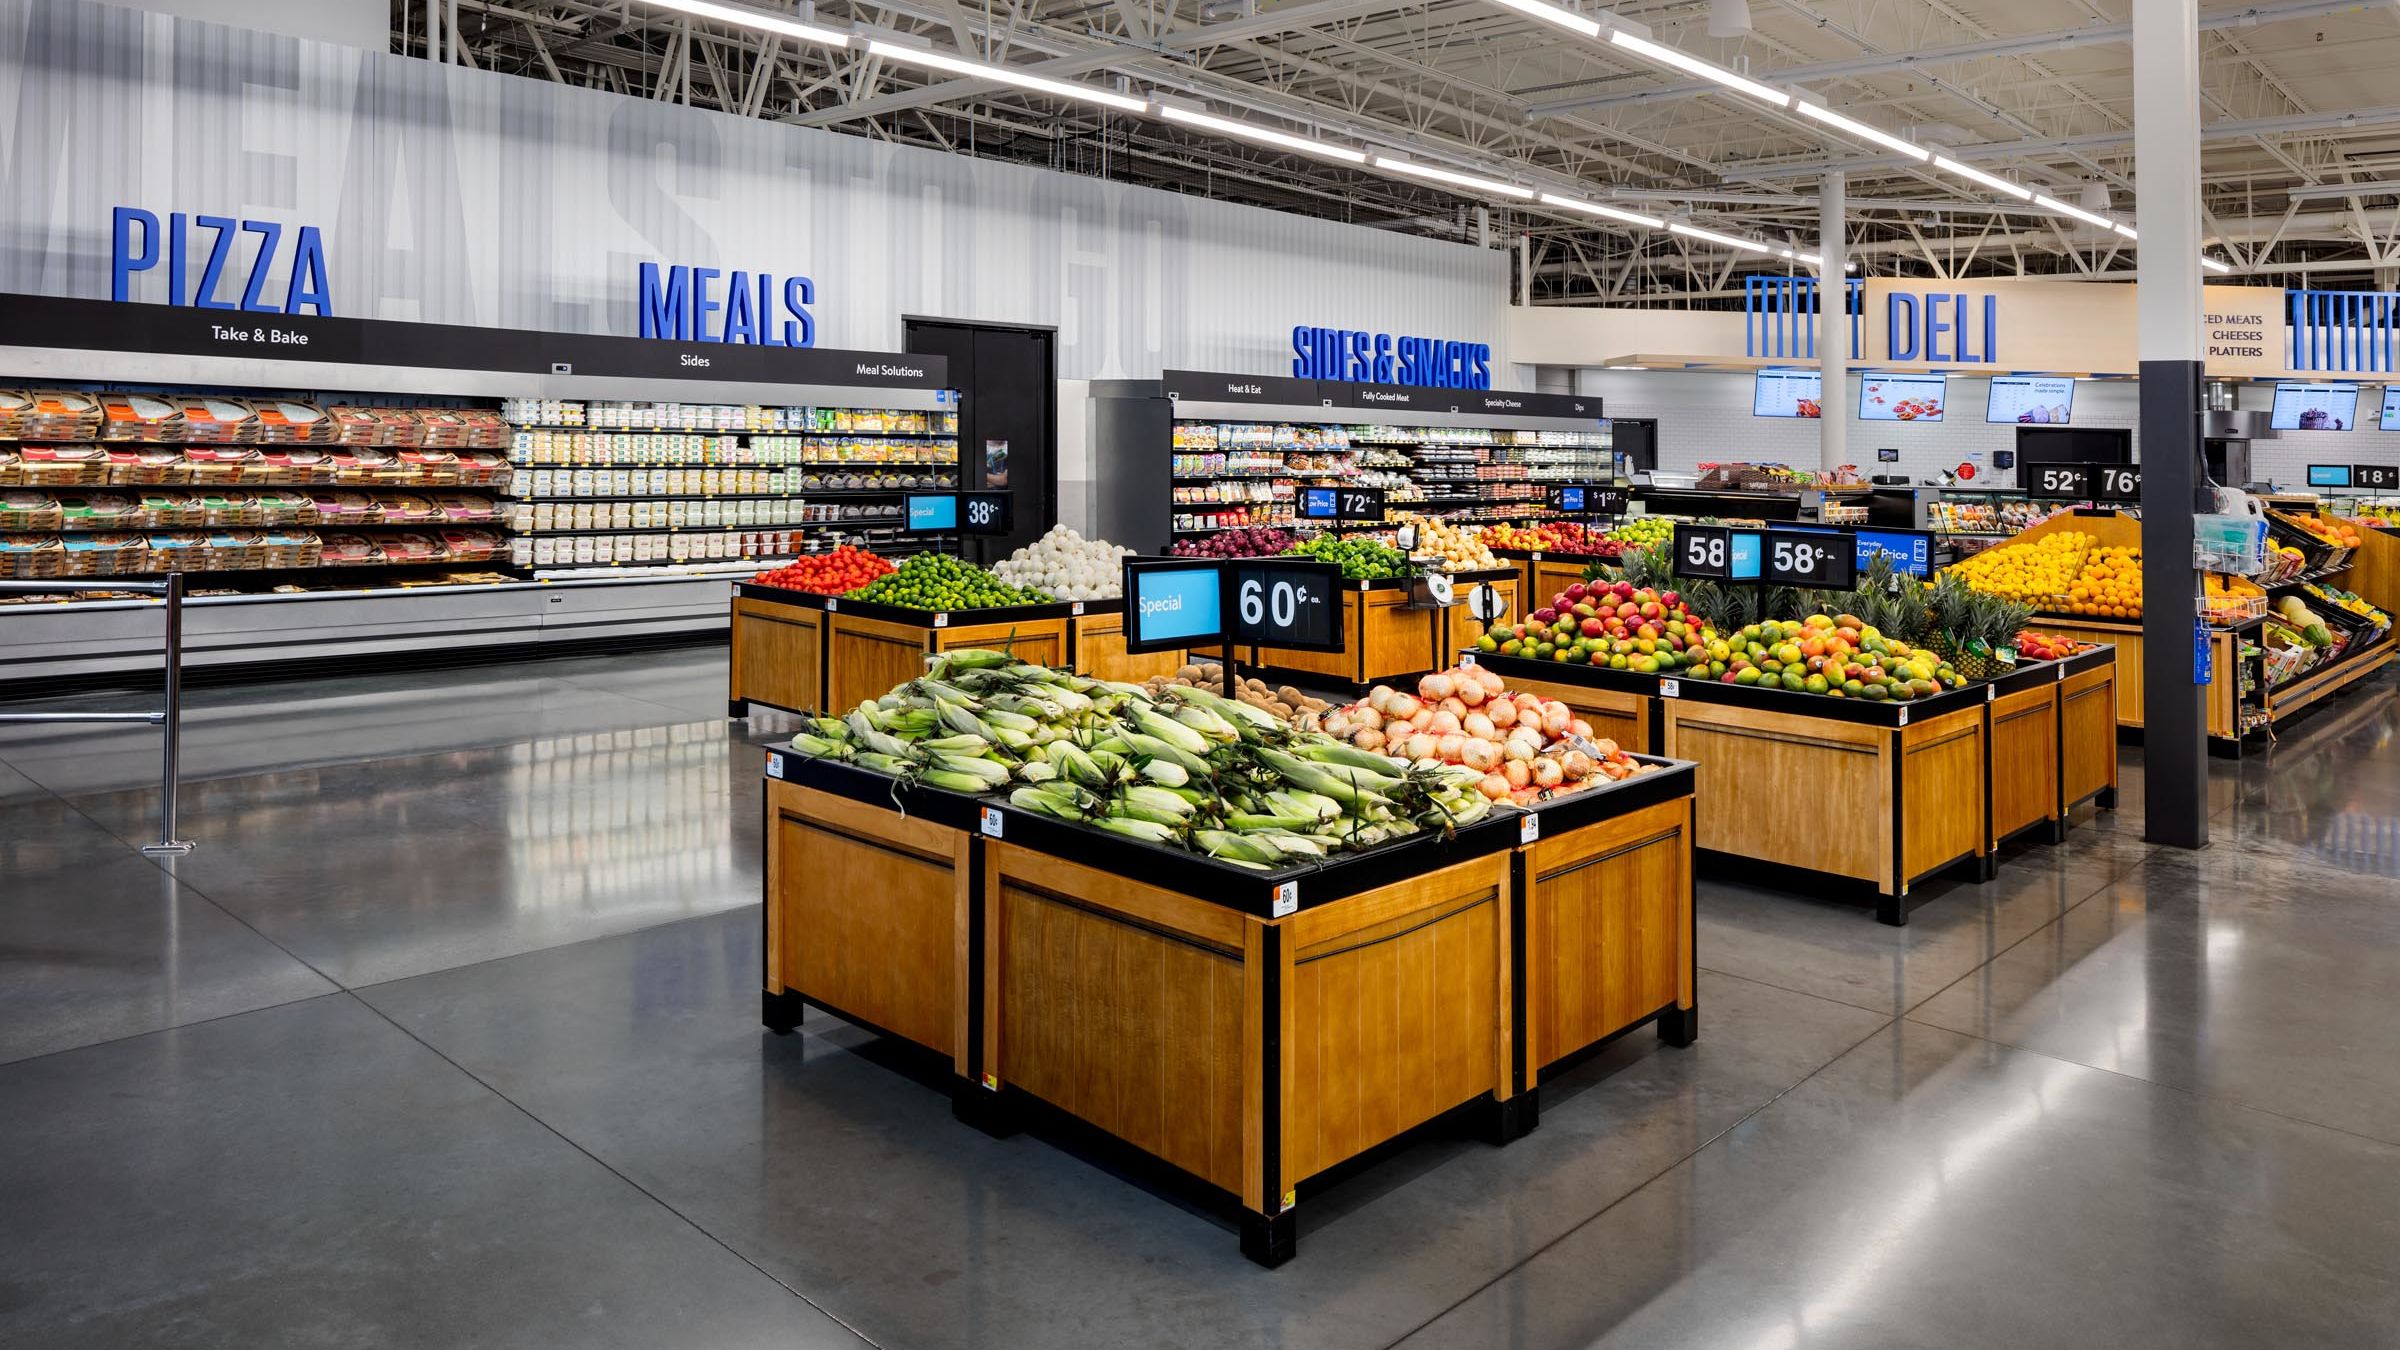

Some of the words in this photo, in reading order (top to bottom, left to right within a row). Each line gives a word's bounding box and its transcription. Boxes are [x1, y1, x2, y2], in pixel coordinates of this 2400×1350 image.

[112, 206, 332, 318] PIZZA
[639, 262, 815, 349] MEALS
[2225, 314, 2263, 325] MEATS
[1888, 292, 1996, 363] DELI
[211, 325, 249, 342] Take
[253, 328, 266, 343] &
[270, 329, 309, 345] Bake
[2212, 330, 2263, 341] CHEESES
[2209, 346, 2263, 357] PLATTERS
[680, 354, 710, 368] Sides
[1293, 325, 1371, 383] SIDES
[1374, 333, 1395, 385] &
[1398, 335, 1490, 391] SNACKS
[856, 363, 880, 377] Meal
[881, 364, 924, 378] Solutions
[1228, 383, 1244, 394] Heat
[1244, 384, 1250, 394] &
[1251, 384, 1262, 395] Eat
[1362, 391, 1376, 403] Fully
[1376, 392, 1396, 402] Cooked
[1396, 393, 1410, 402] Meat
[1484, 398, 1506, 409] Specialty
[1505, 399, 1522, 408] Cheese
[1574, 403, 1585, 412] Dips
[909, 507, 935, 518] Special
[1857, 540, 1882, 549] Everyday
[1688, 536, 1725, 568] 58
[1881, 548, 1909, 560] Price
[1139, 593, 1182, 618] Special
